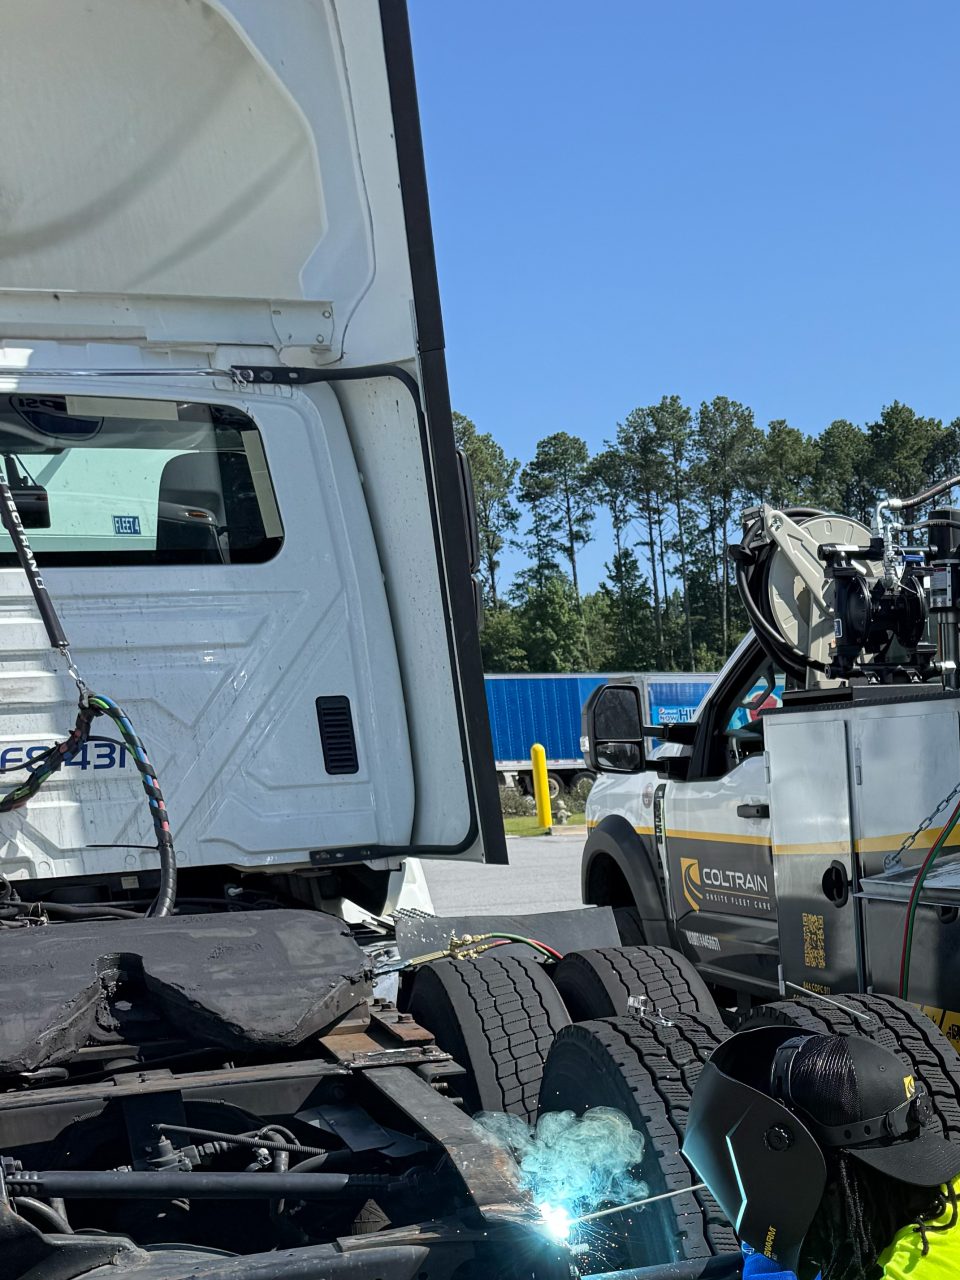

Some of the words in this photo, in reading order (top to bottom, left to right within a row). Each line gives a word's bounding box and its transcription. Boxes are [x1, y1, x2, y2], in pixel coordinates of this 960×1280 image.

[3, 489, 39, 572] TECTRAN
[114, 517, 134, 533] FLEET
[134, 517, 140, 533] 4
[0, 742, 126, 773] F8431
[702, 868, 768, 893] COLTRAIN
[705, 892, 728, 904] ONSITE
[731, 897, 750, 907] FLEET
[754, 901, 771, 911] CARE
